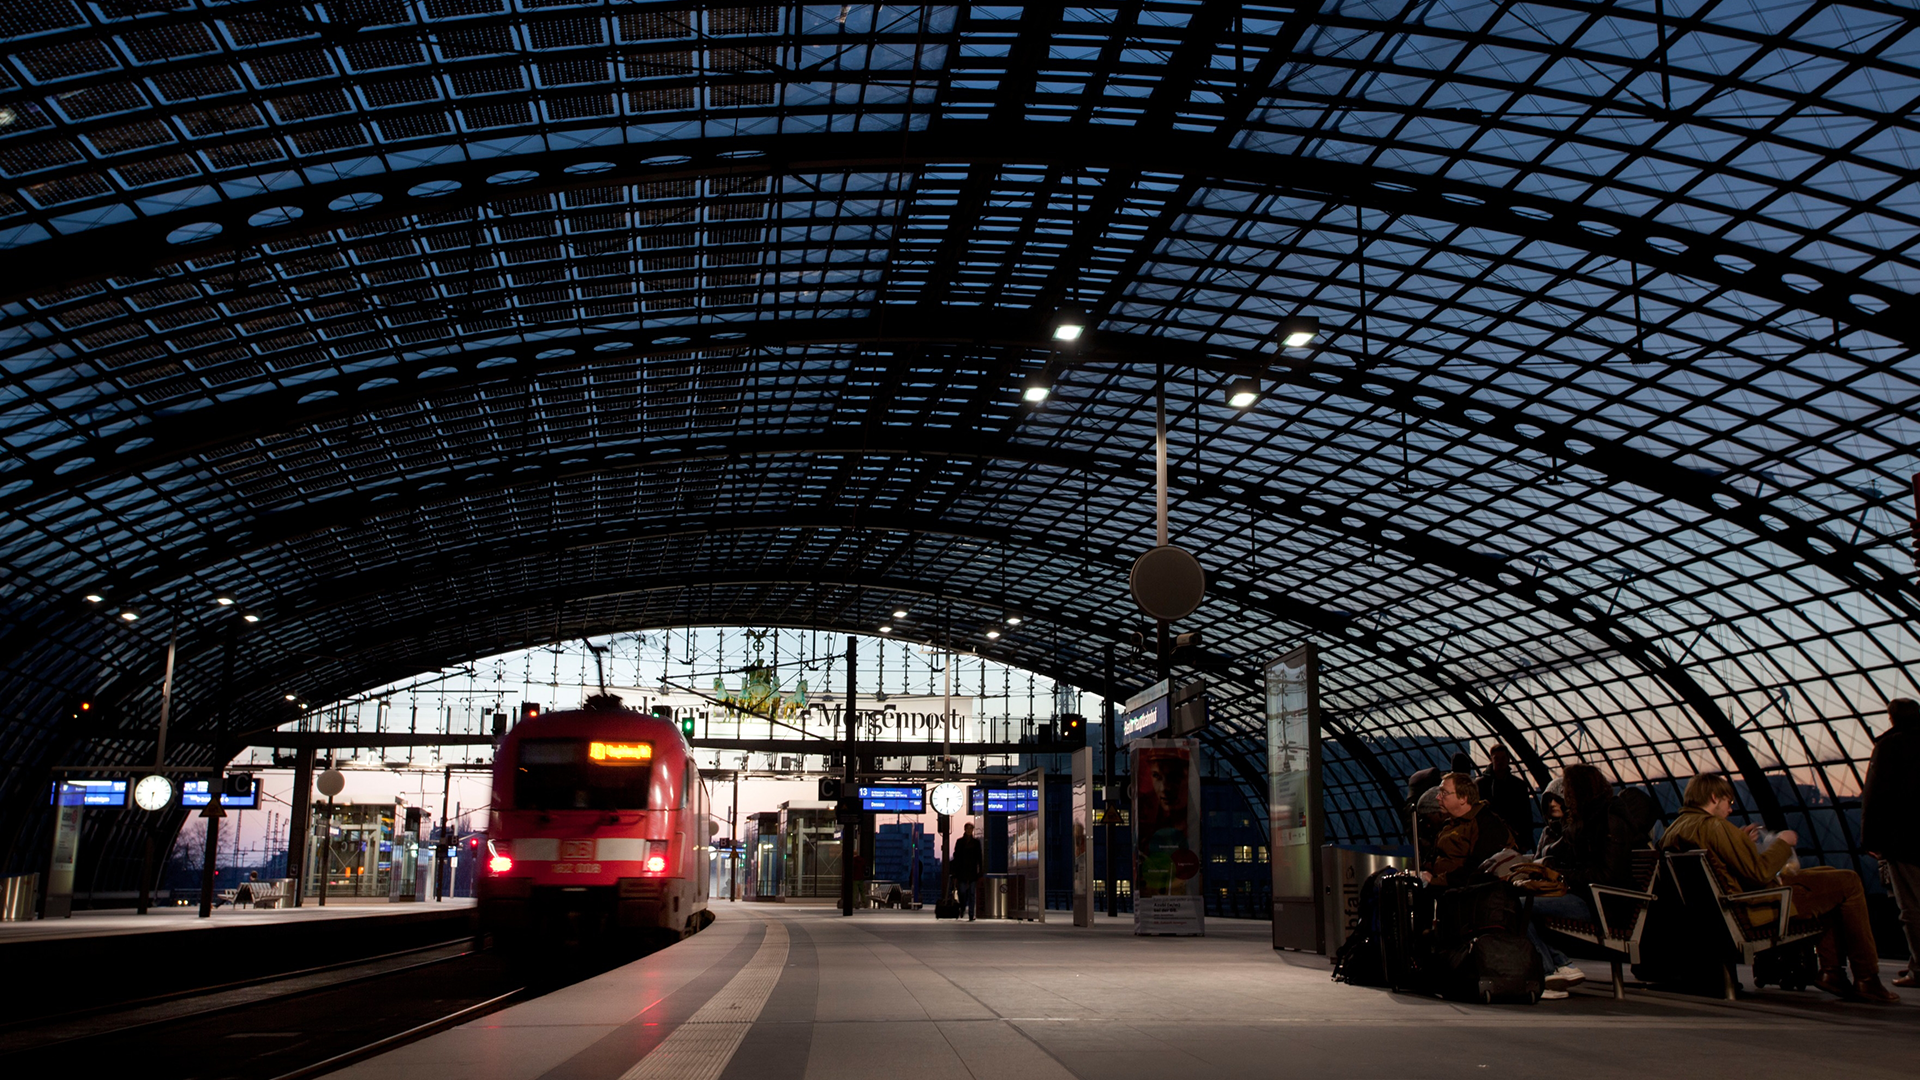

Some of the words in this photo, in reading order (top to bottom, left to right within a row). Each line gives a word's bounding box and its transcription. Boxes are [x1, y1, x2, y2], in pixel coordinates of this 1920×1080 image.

[817, 703, 961, 736] Mrgenpost
[235, 774, 250, 793] C
[821, 780, 834, 797] C
[859, 788, 868, 796] 13
[1343, 883, 1360, 940] bfall
